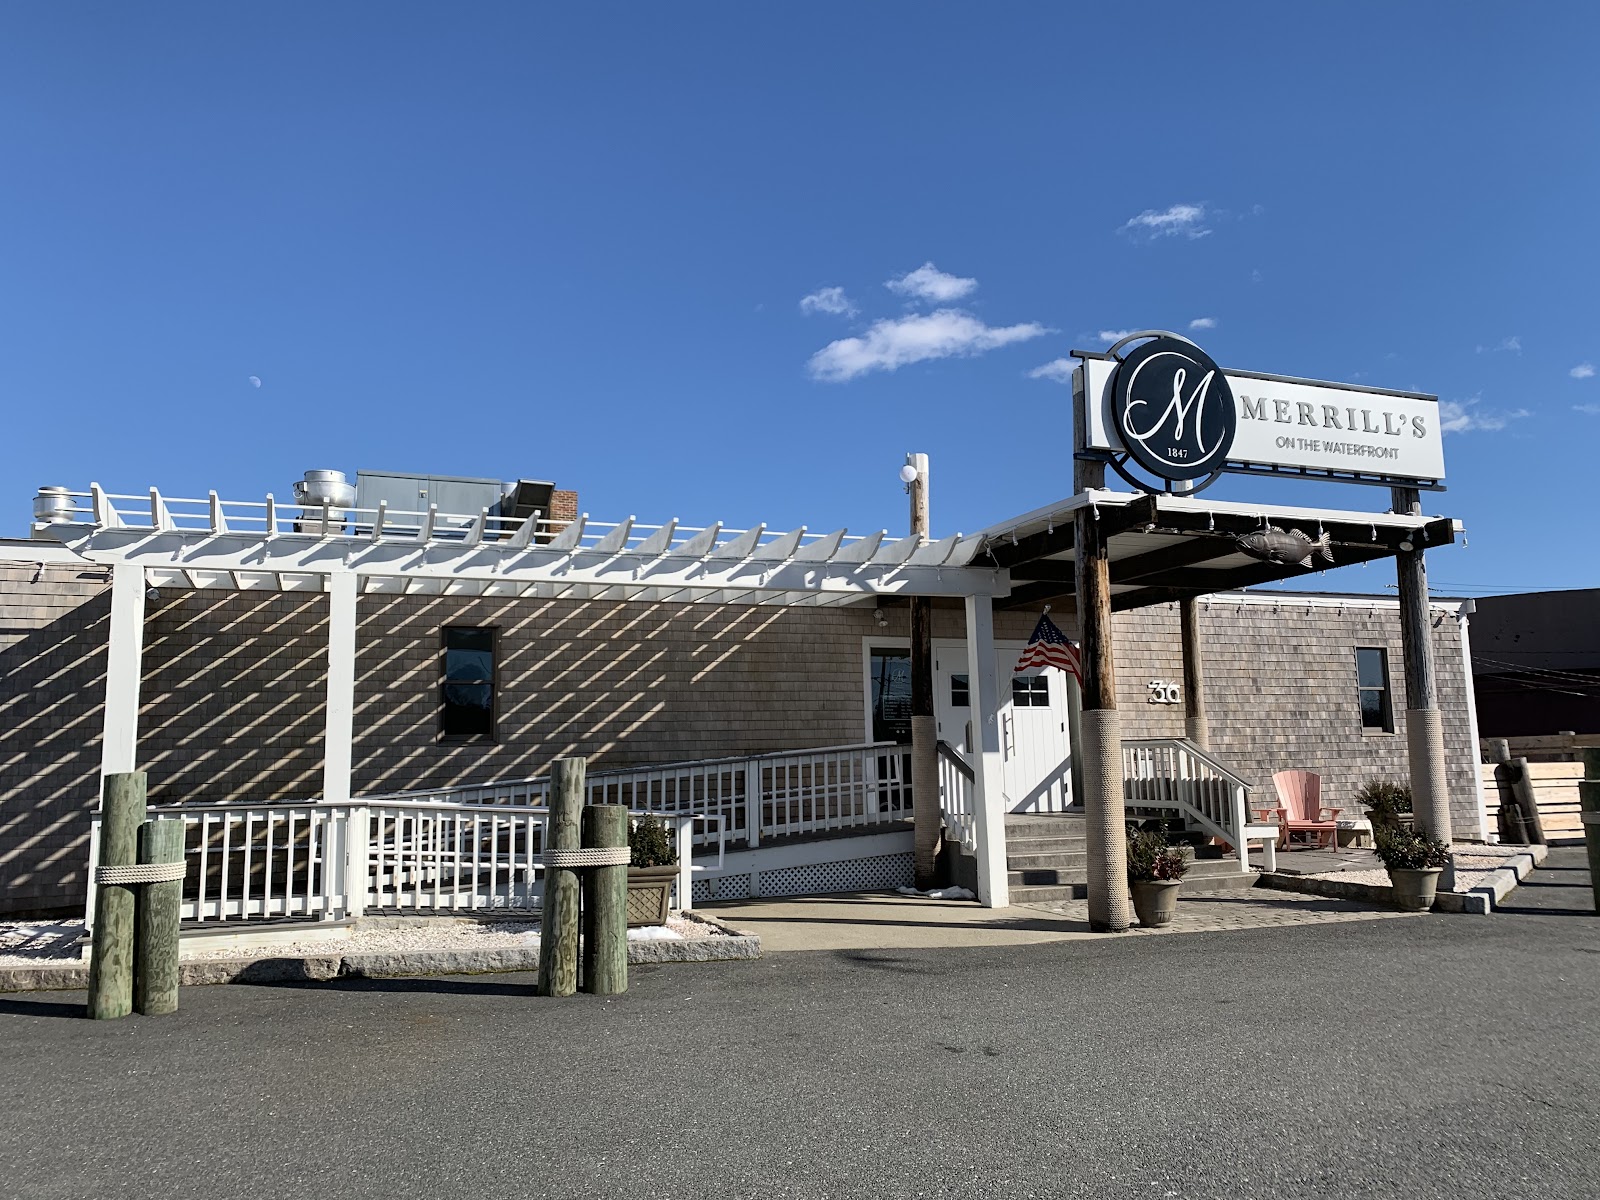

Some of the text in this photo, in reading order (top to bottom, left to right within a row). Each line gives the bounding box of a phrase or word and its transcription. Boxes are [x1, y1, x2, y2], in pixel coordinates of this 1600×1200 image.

[1123, 368, 1215, 454] M
[1240, 395, 1427, 438] MERRILL'S
[1167, 447, 1188, 458] 1847
[1276, 435, 1399, 460] ON THE WATERFRONT
[1148, 680, 1181, 703] 36
